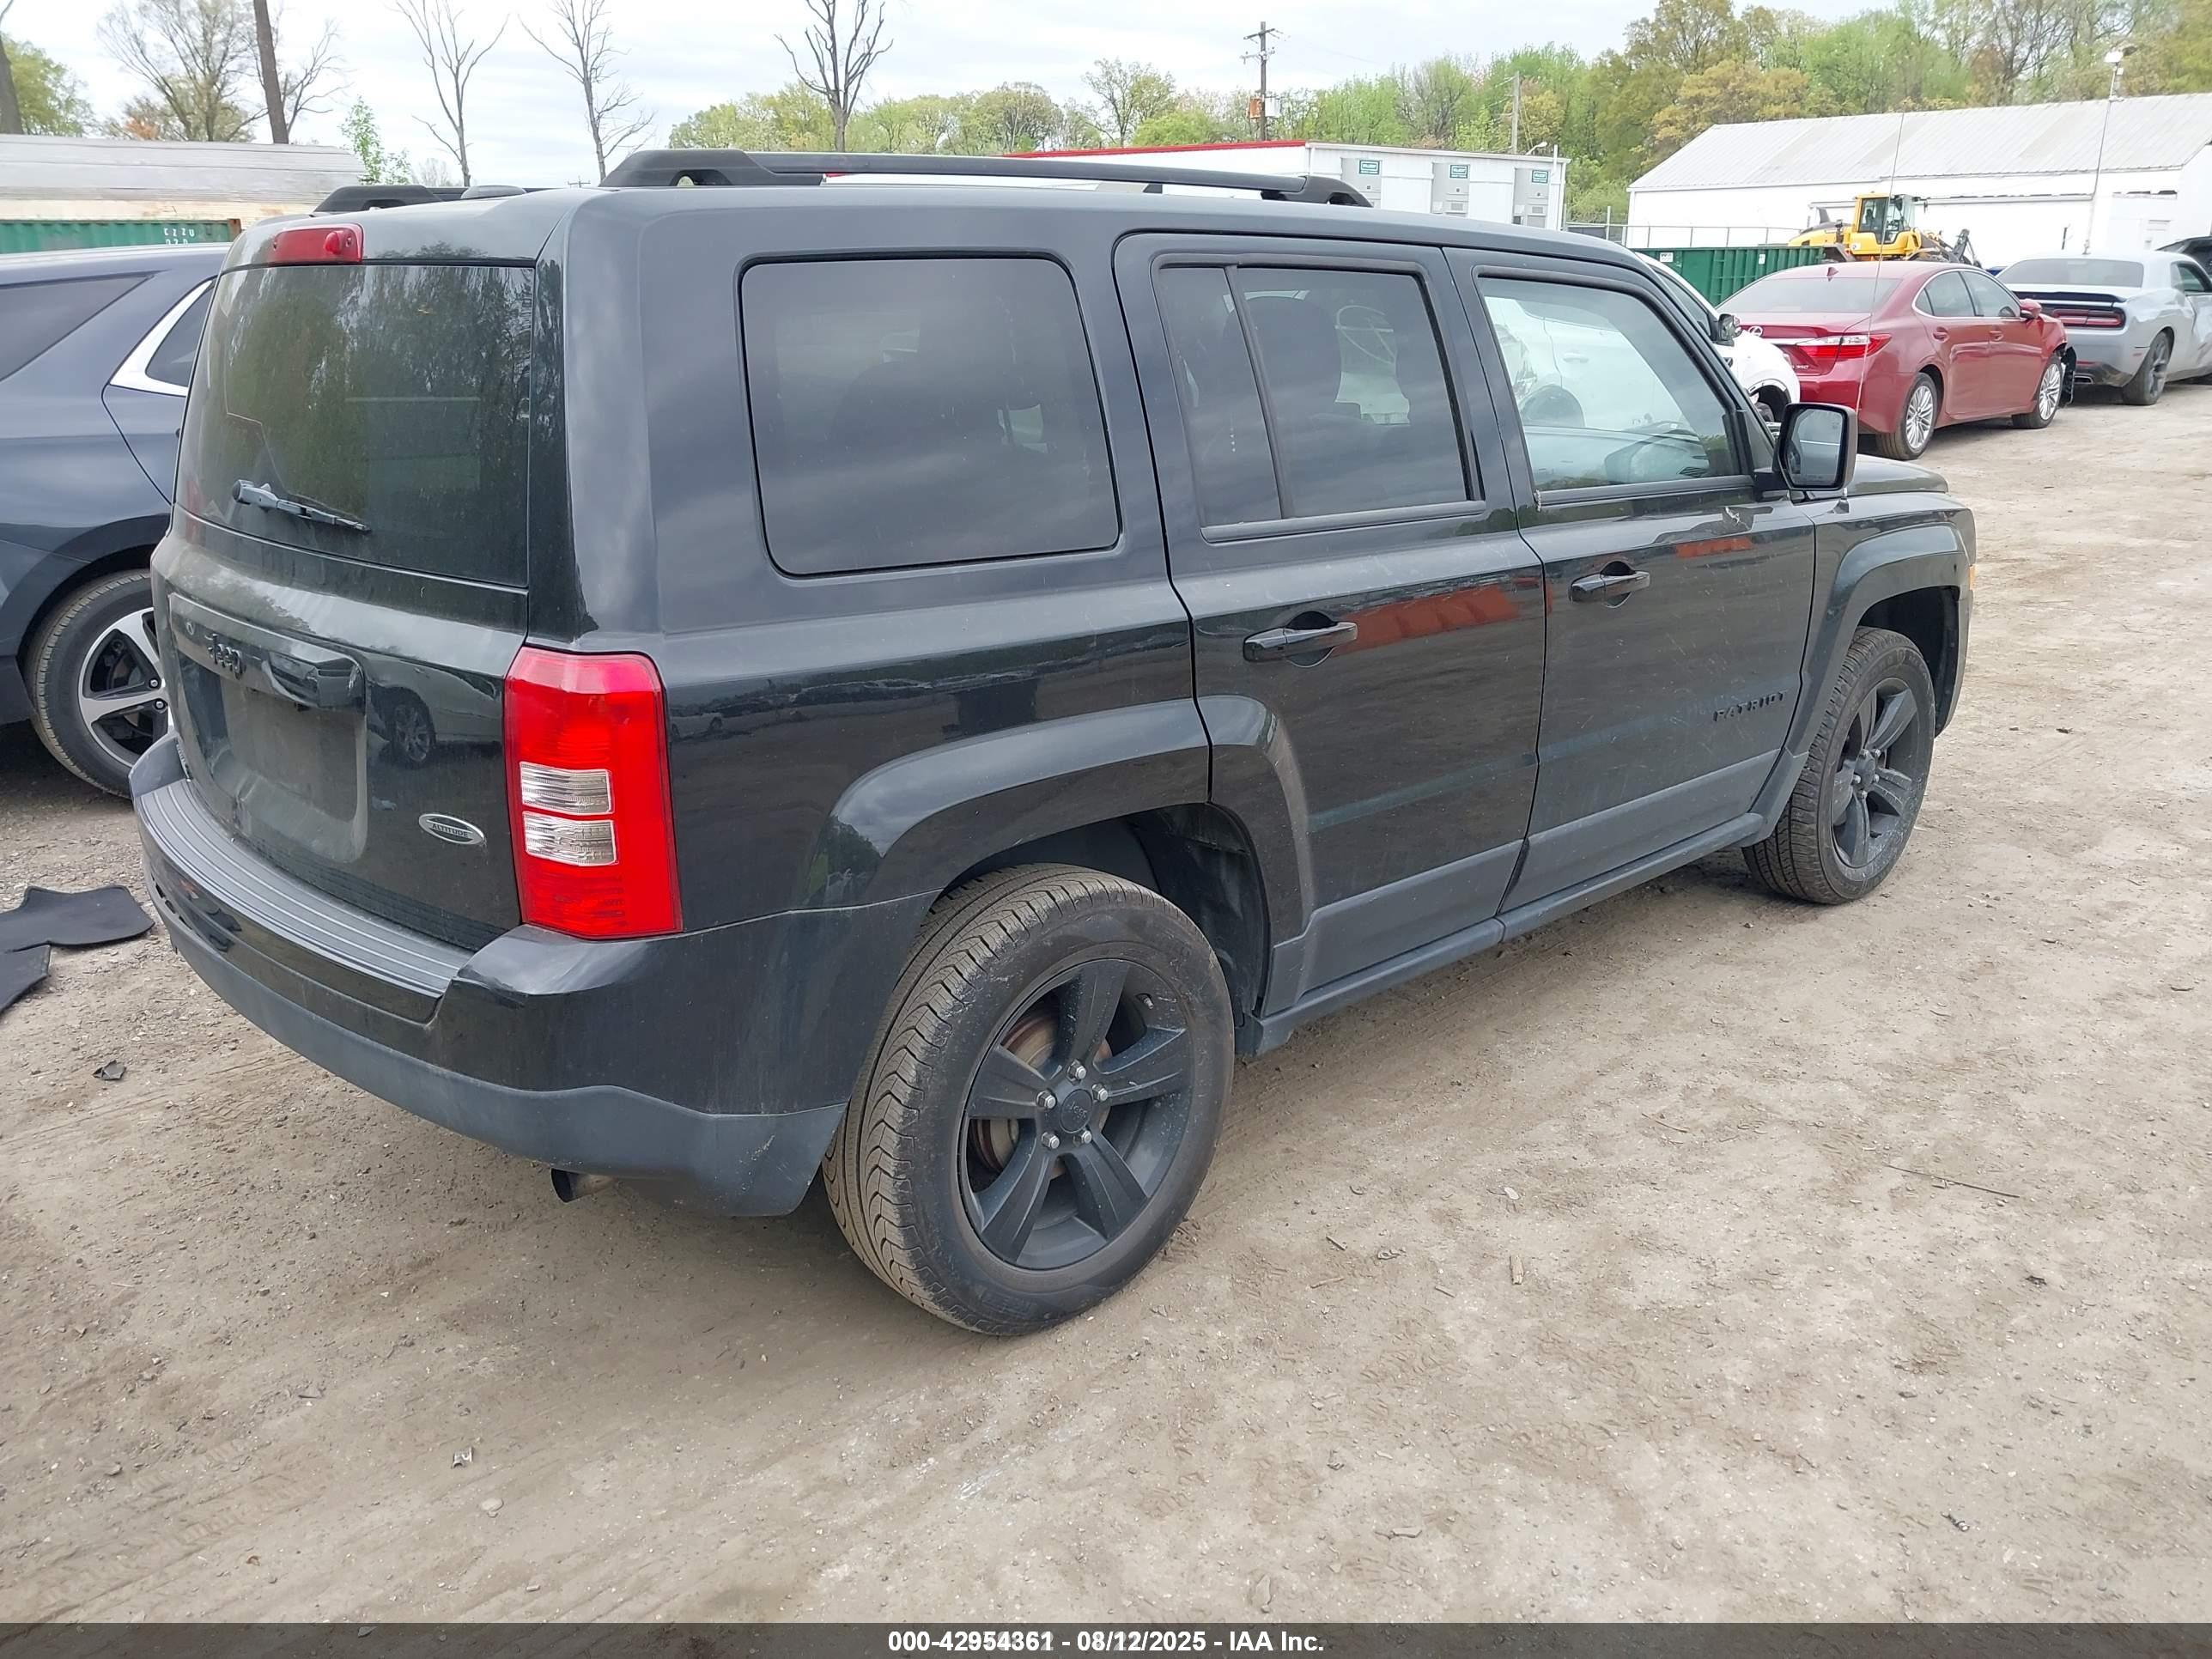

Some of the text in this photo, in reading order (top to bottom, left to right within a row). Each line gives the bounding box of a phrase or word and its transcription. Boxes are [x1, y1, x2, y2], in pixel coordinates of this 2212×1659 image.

[204, 634, 245, 679] Jeep
[1713, 689, 1788, 722] PATRIOT
[432, 823, 468, 839] ALTITUDE
